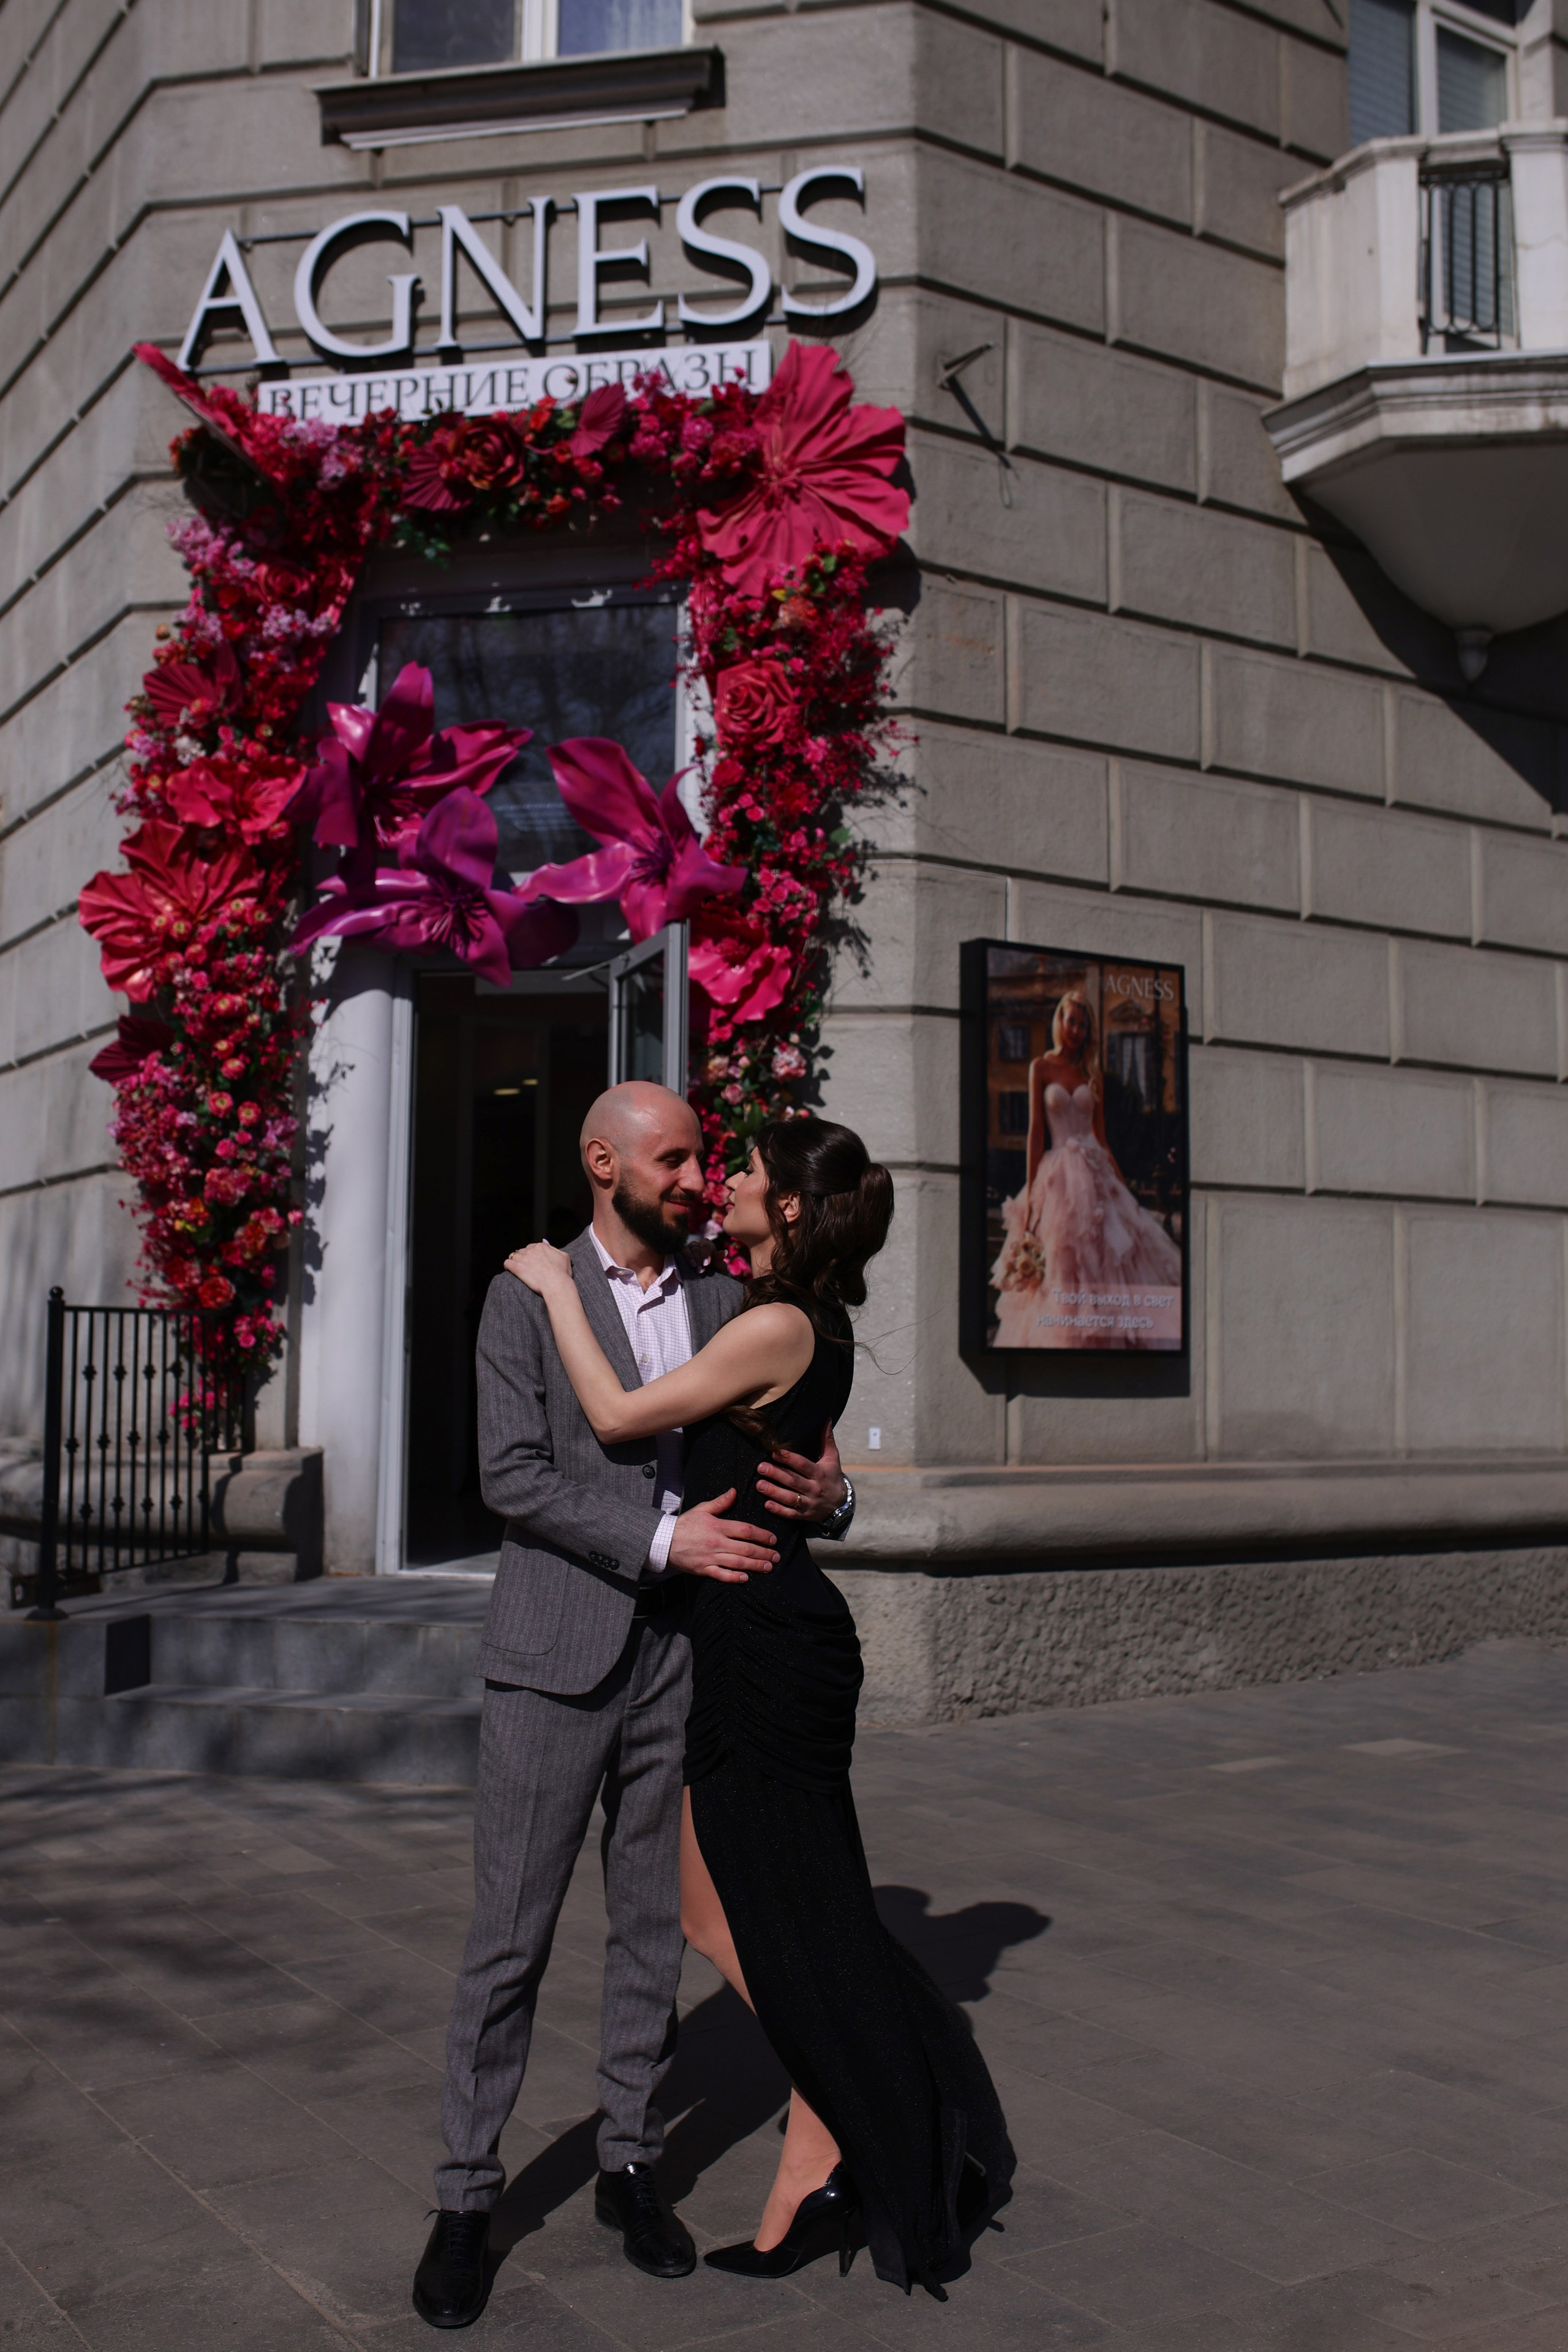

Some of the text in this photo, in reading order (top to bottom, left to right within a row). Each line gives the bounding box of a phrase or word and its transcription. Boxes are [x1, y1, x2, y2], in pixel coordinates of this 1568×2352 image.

[177, 166, 878, 368] AGNESS
[268, 368, 530, 420] ВЕЧЕРНИЕ
[1104, 974, 1174, 1001] AGNESS
[1053, 1289, 1175, 1308] Твой выход в свет
[1036, 1315, 1155, 1330] начинается здесь
